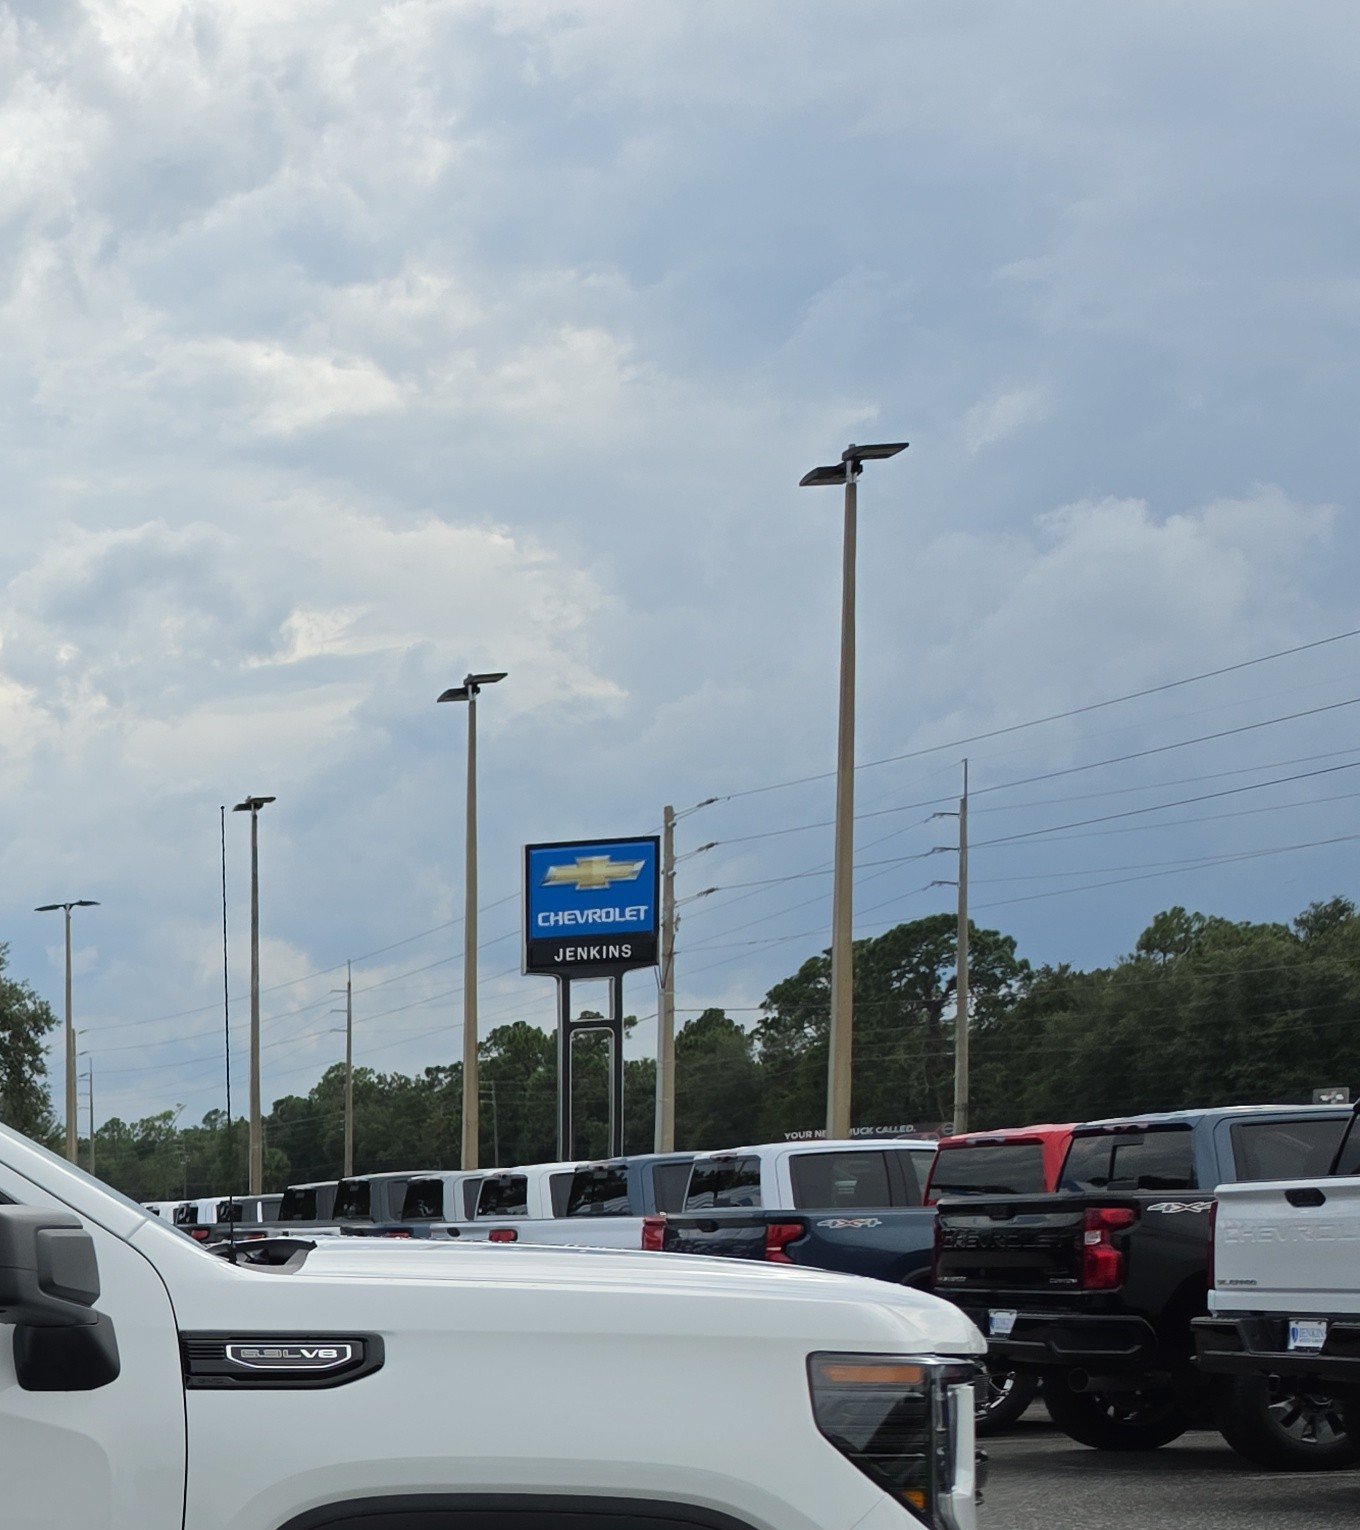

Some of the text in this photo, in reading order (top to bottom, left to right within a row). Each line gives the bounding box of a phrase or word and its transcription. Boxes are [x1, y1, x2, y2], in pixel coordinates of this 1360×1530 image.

[538, 905, 648, 926] CHEVROLET
[554, 944, 632, 962] JENKINS
[784, 1130, 813, 1140] YOUR
[850, 1127, 874, 1136] UCK
[876, 1124, 917, 1134] CALLED.
